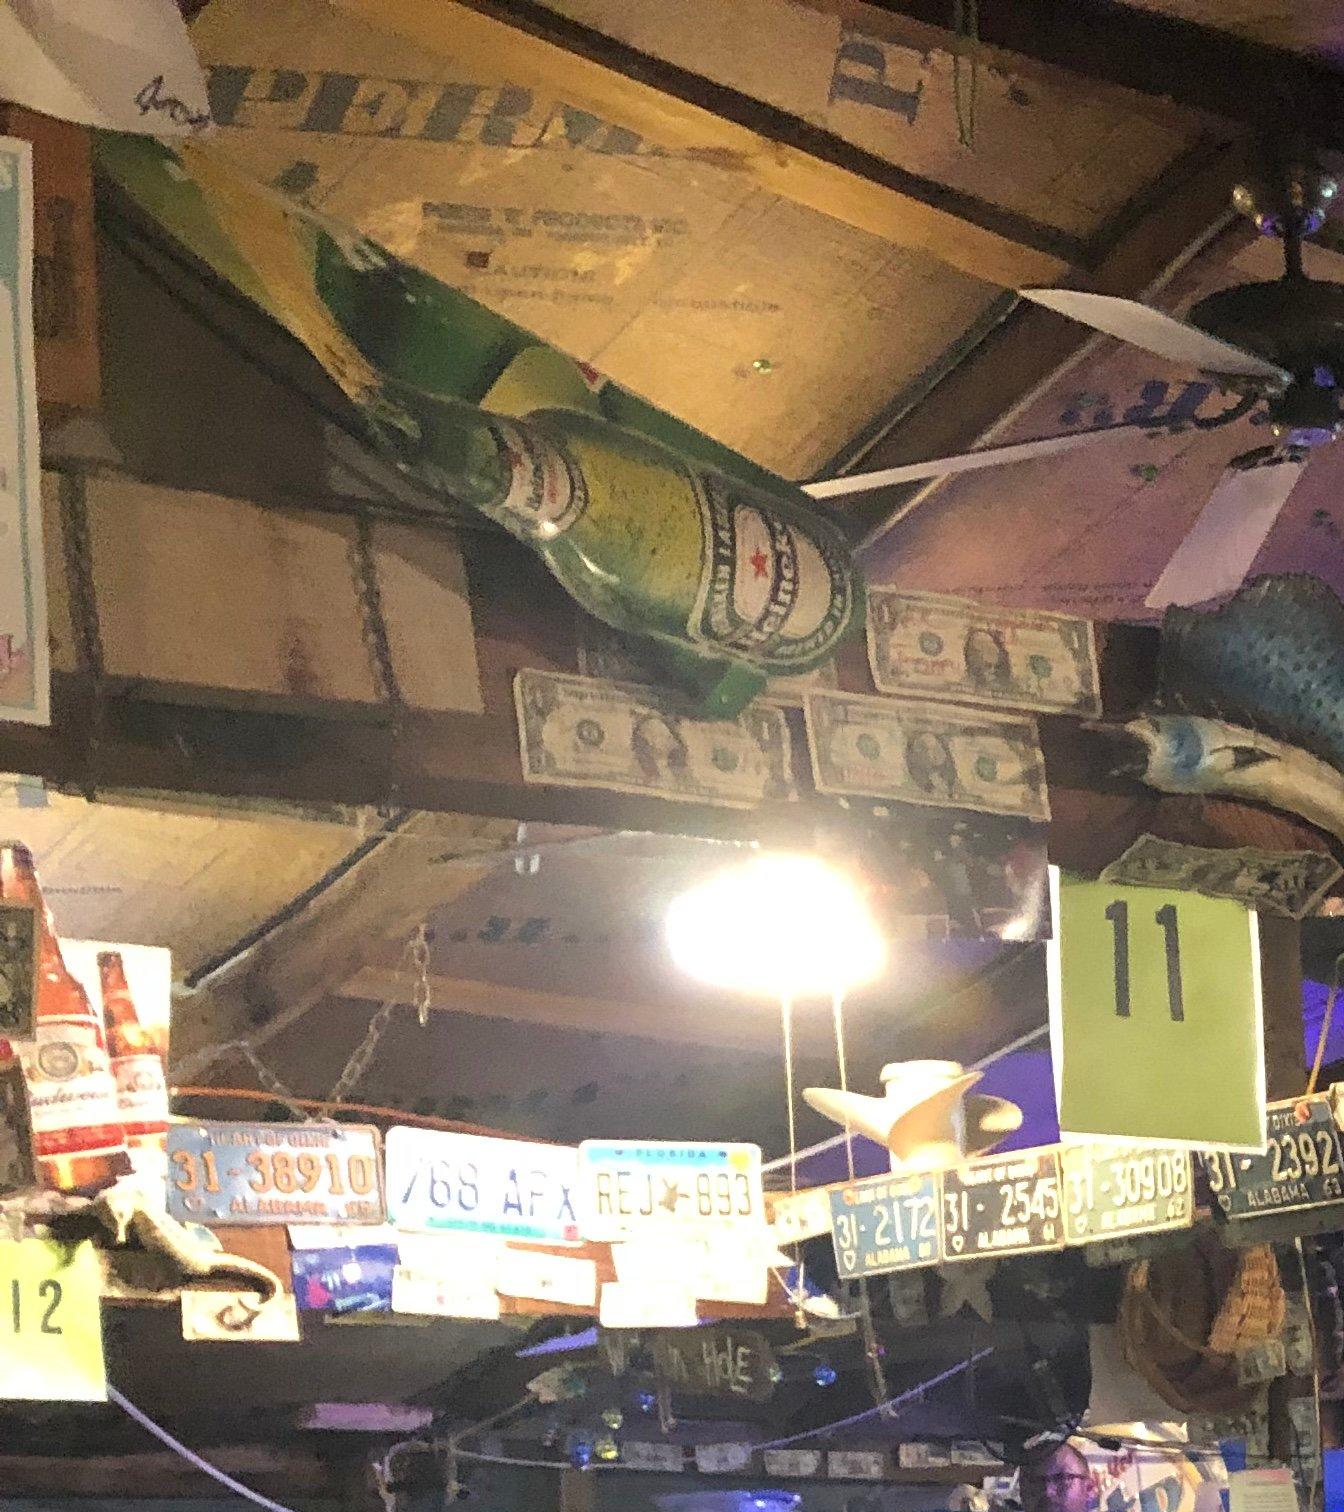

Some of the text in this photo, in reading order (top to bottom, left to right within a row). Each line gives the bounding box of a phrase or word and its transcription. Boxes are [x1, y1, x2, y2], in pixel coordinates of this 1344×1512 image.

[1104, 899, 1185, 1022] 11
[635, 1148, 708, 1160] FLORIDA
[1247, 1183, 1311, 1208] ALABAMA
[8, 1278, 64, 1336] 12
